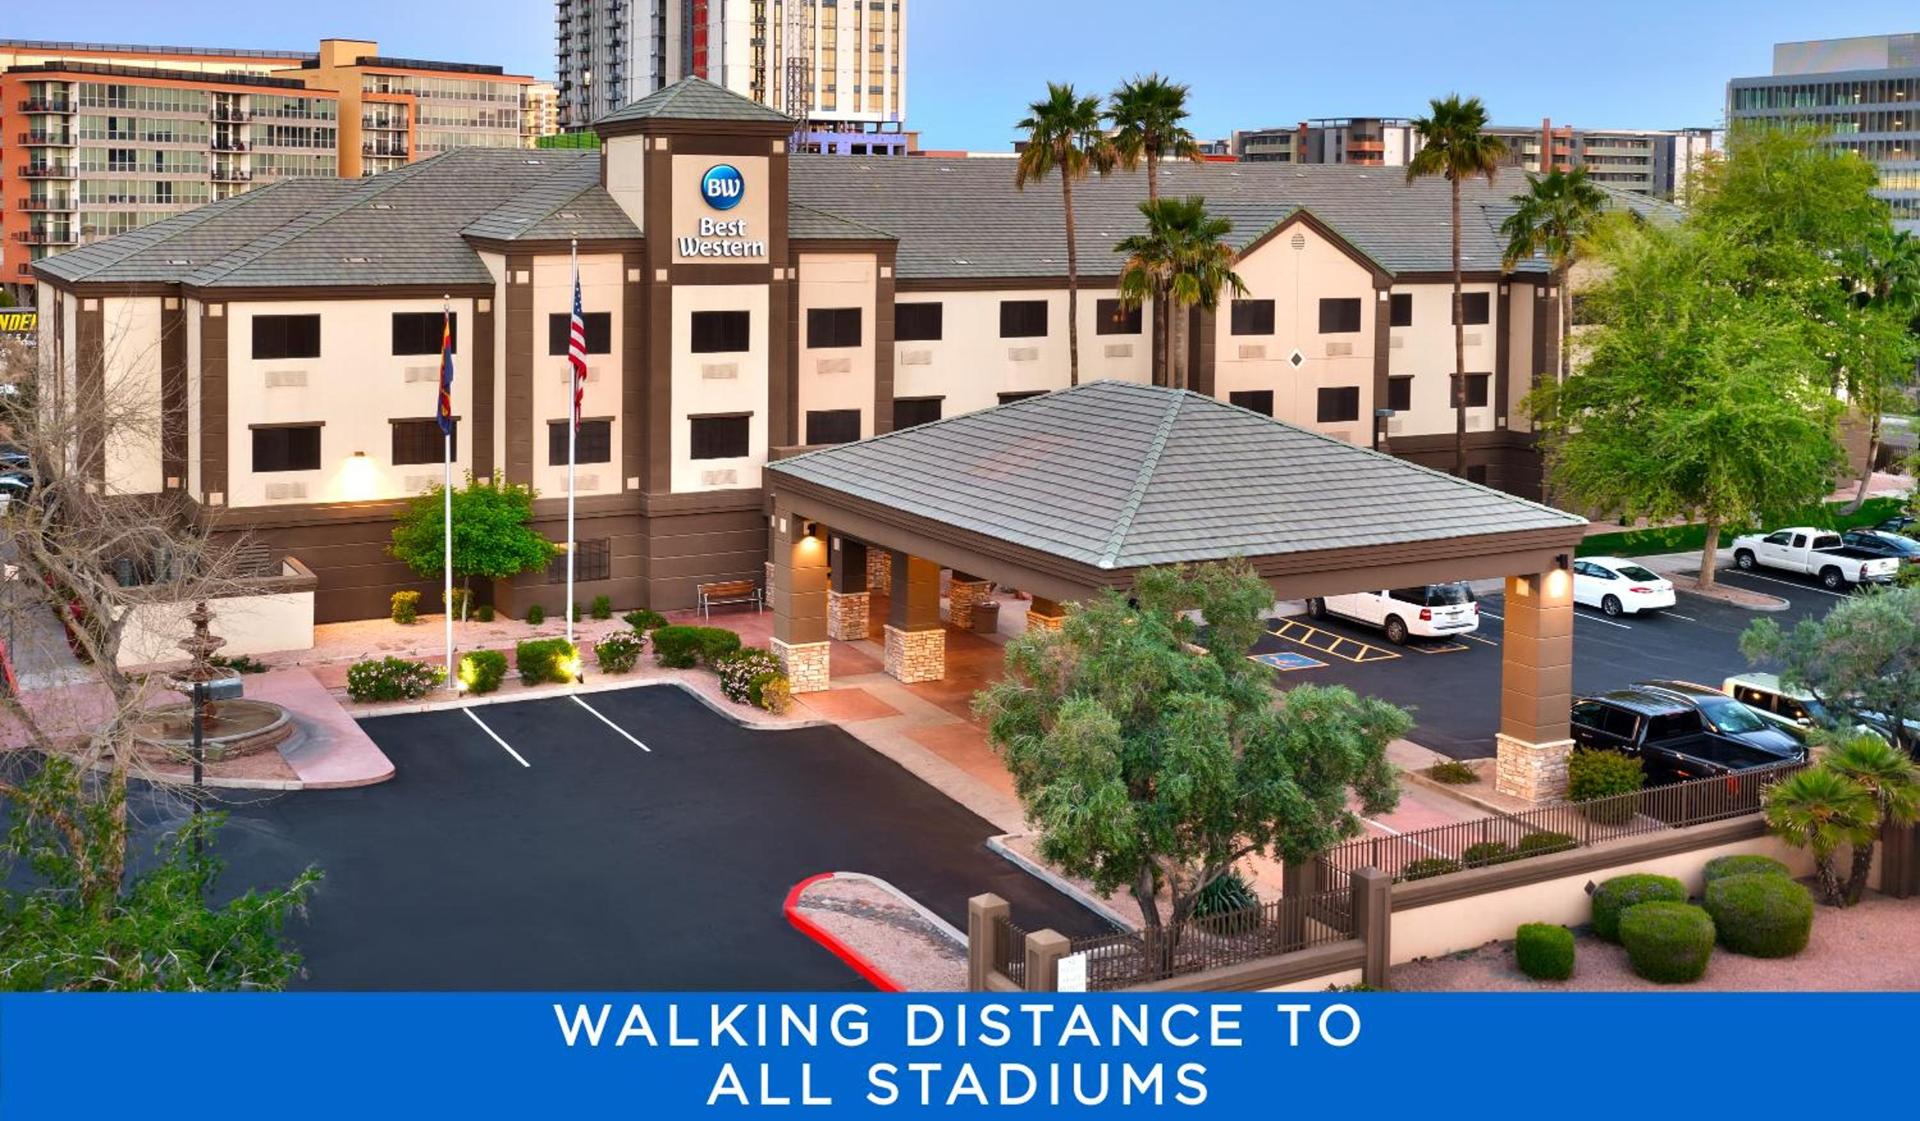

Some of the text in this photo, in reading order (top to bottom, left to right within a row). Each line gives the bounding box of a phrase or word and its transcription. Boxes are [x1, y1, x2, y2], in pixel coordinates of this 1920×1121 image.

[707, 178, 741, 198] BW
[699, 217, 747, 237] Best
[678, 236, 765, 257] Western
